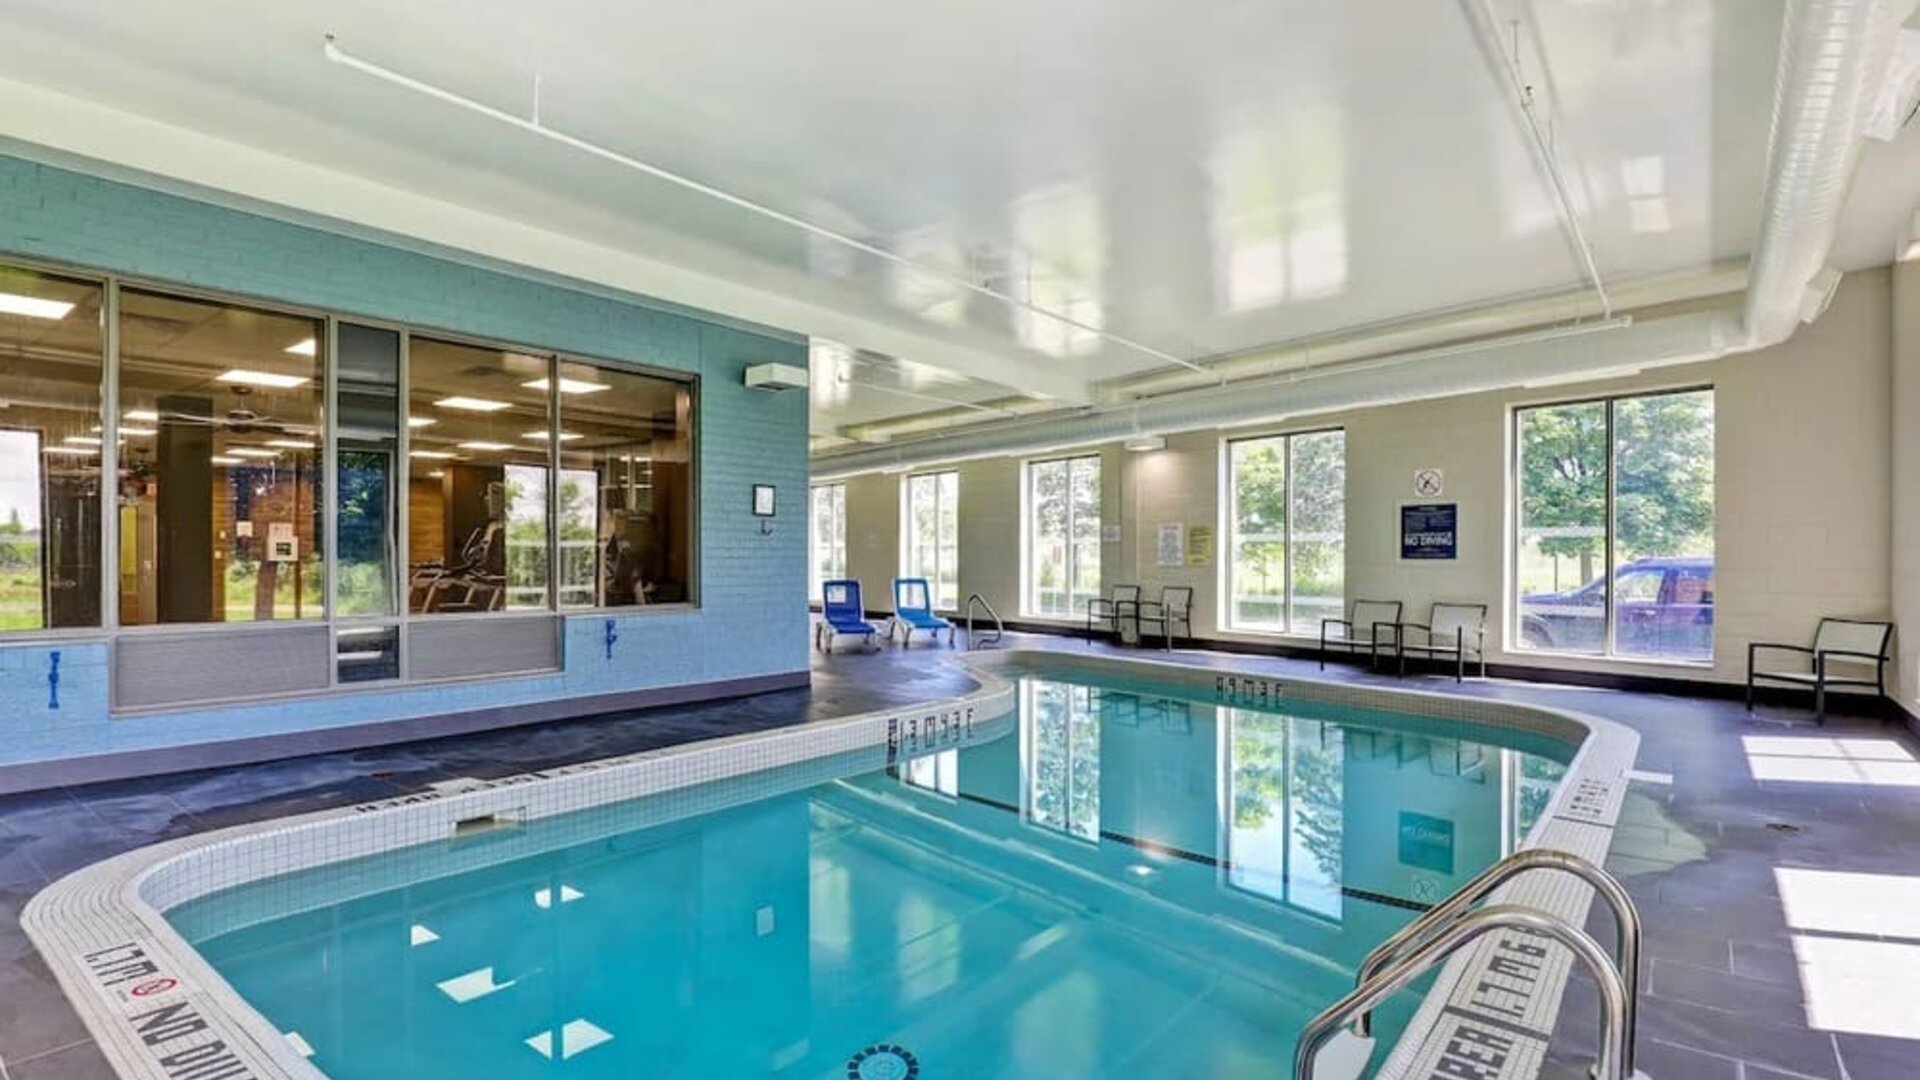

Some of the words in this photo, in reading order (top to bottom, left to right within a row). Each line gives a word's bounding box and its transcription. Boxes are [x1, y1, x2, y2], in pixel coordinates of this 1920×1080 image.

[1404, 534, 1419, 546] NO
[1420, 533, 1453, 546] DIVING
[83, 942, 159, 987] 1.7M
[129, 1001, 208, 1046] NO
